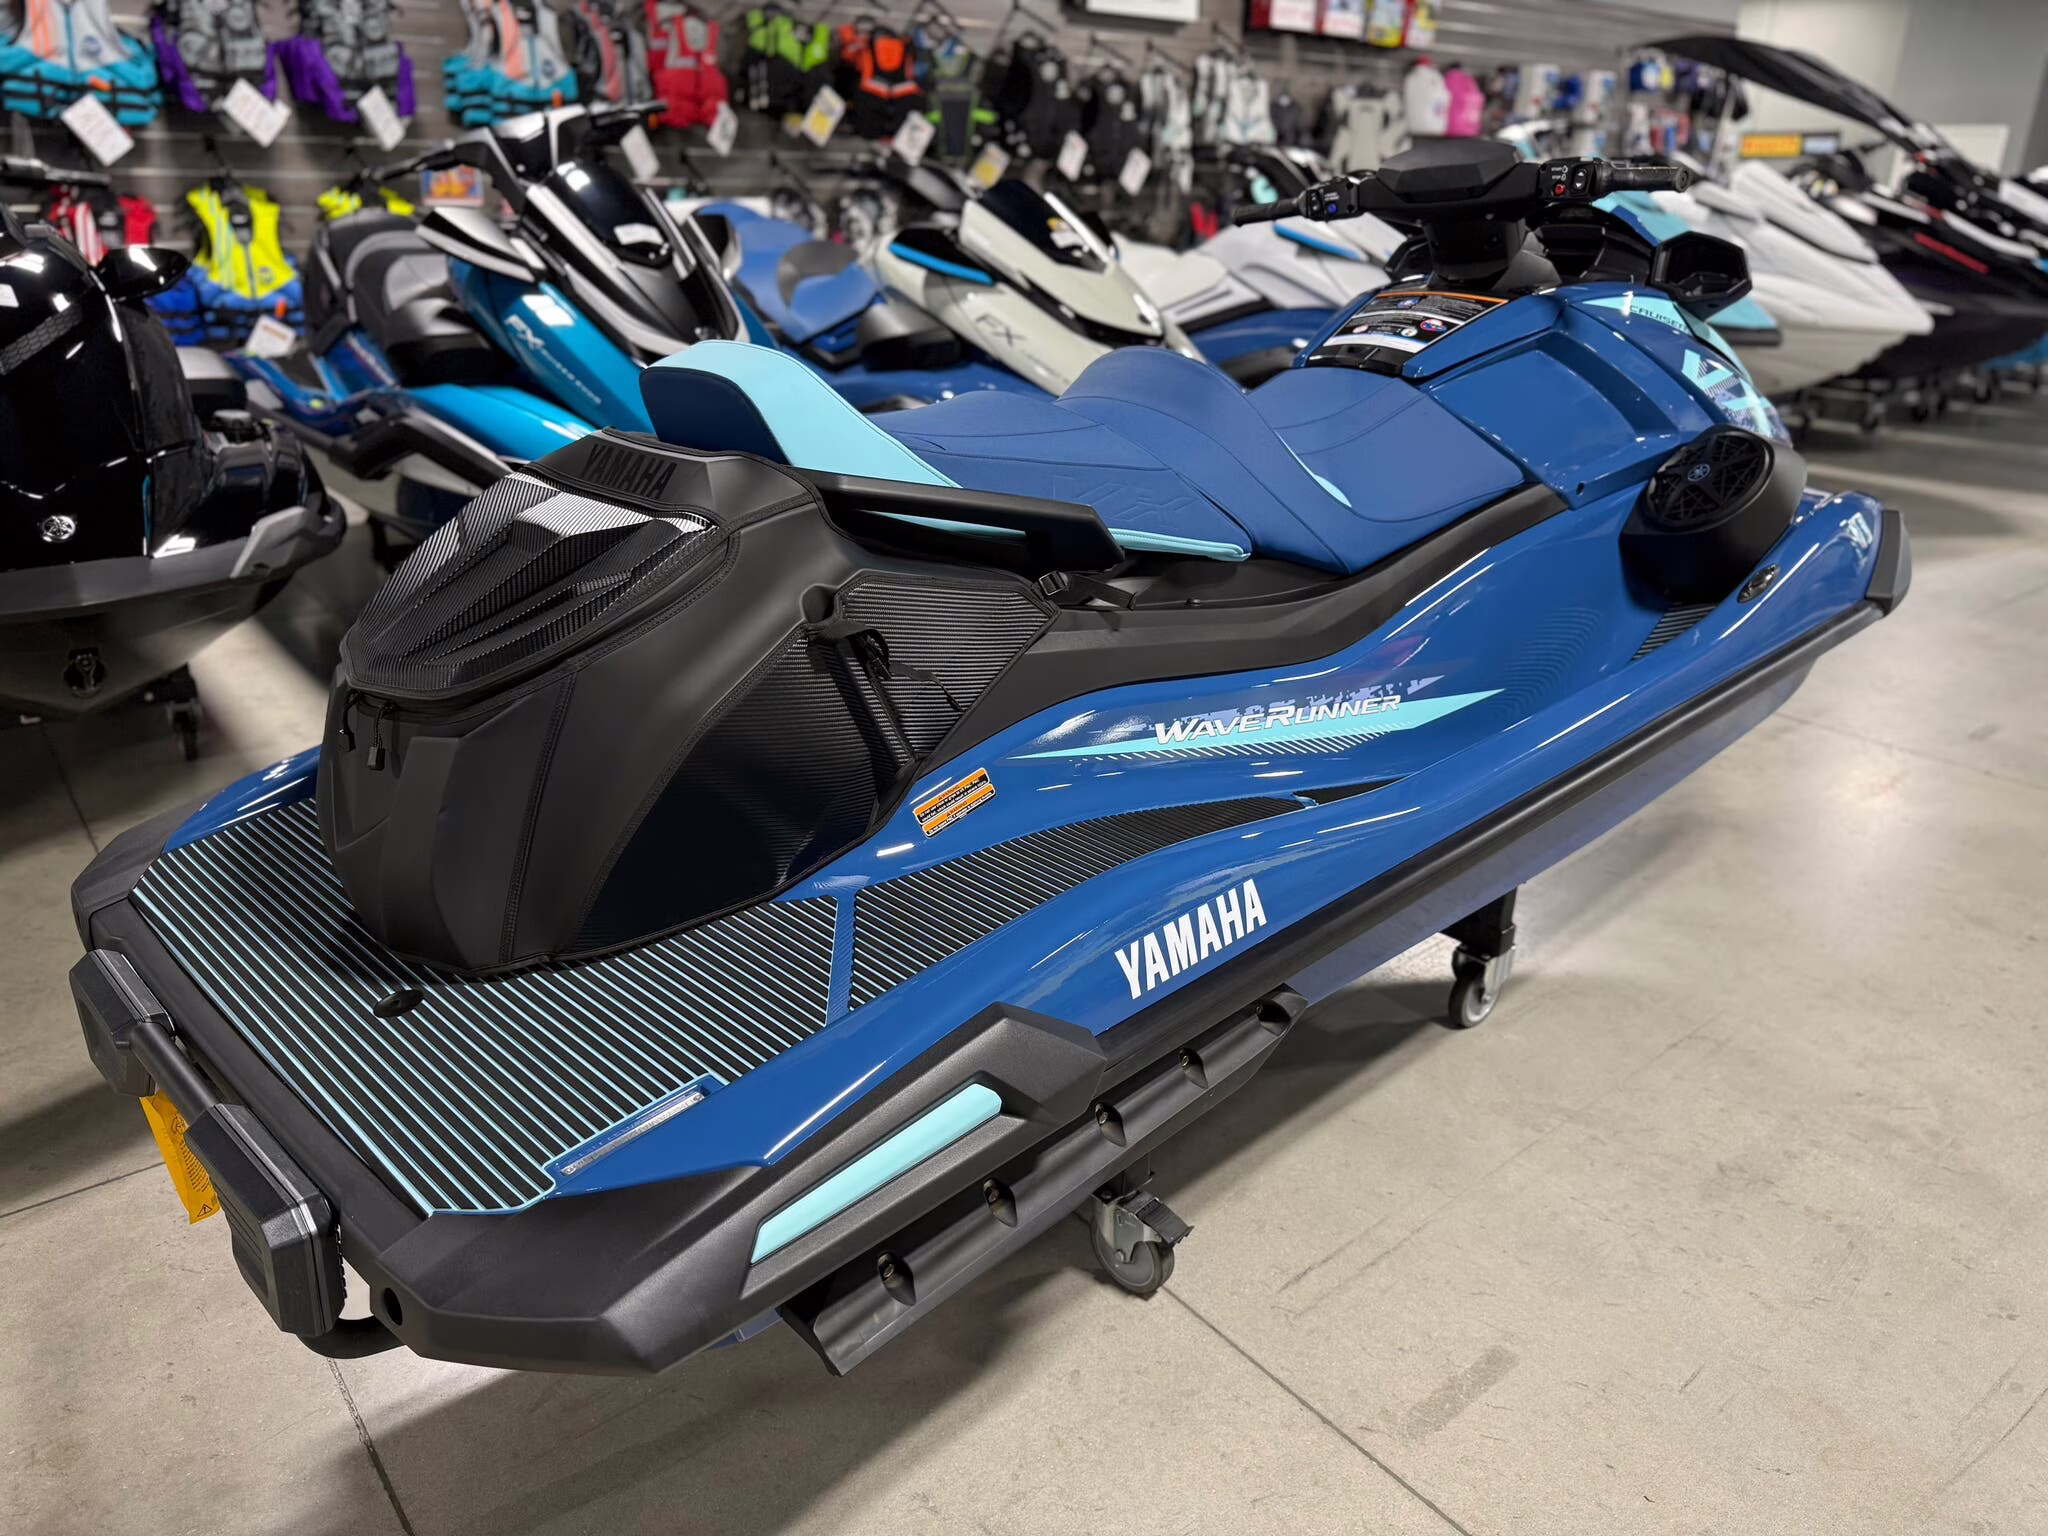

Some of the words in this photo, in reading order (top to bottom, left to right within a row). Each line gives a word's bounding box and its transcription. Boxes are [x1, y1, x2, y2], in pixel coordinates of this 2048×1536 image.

[504, 314, 545, 350] FX
[976, 313, 1027, 347] FX
[582, 443, 678, 500] YAMAHA
[1116, 878, 1268, 1000] YAMAHA
